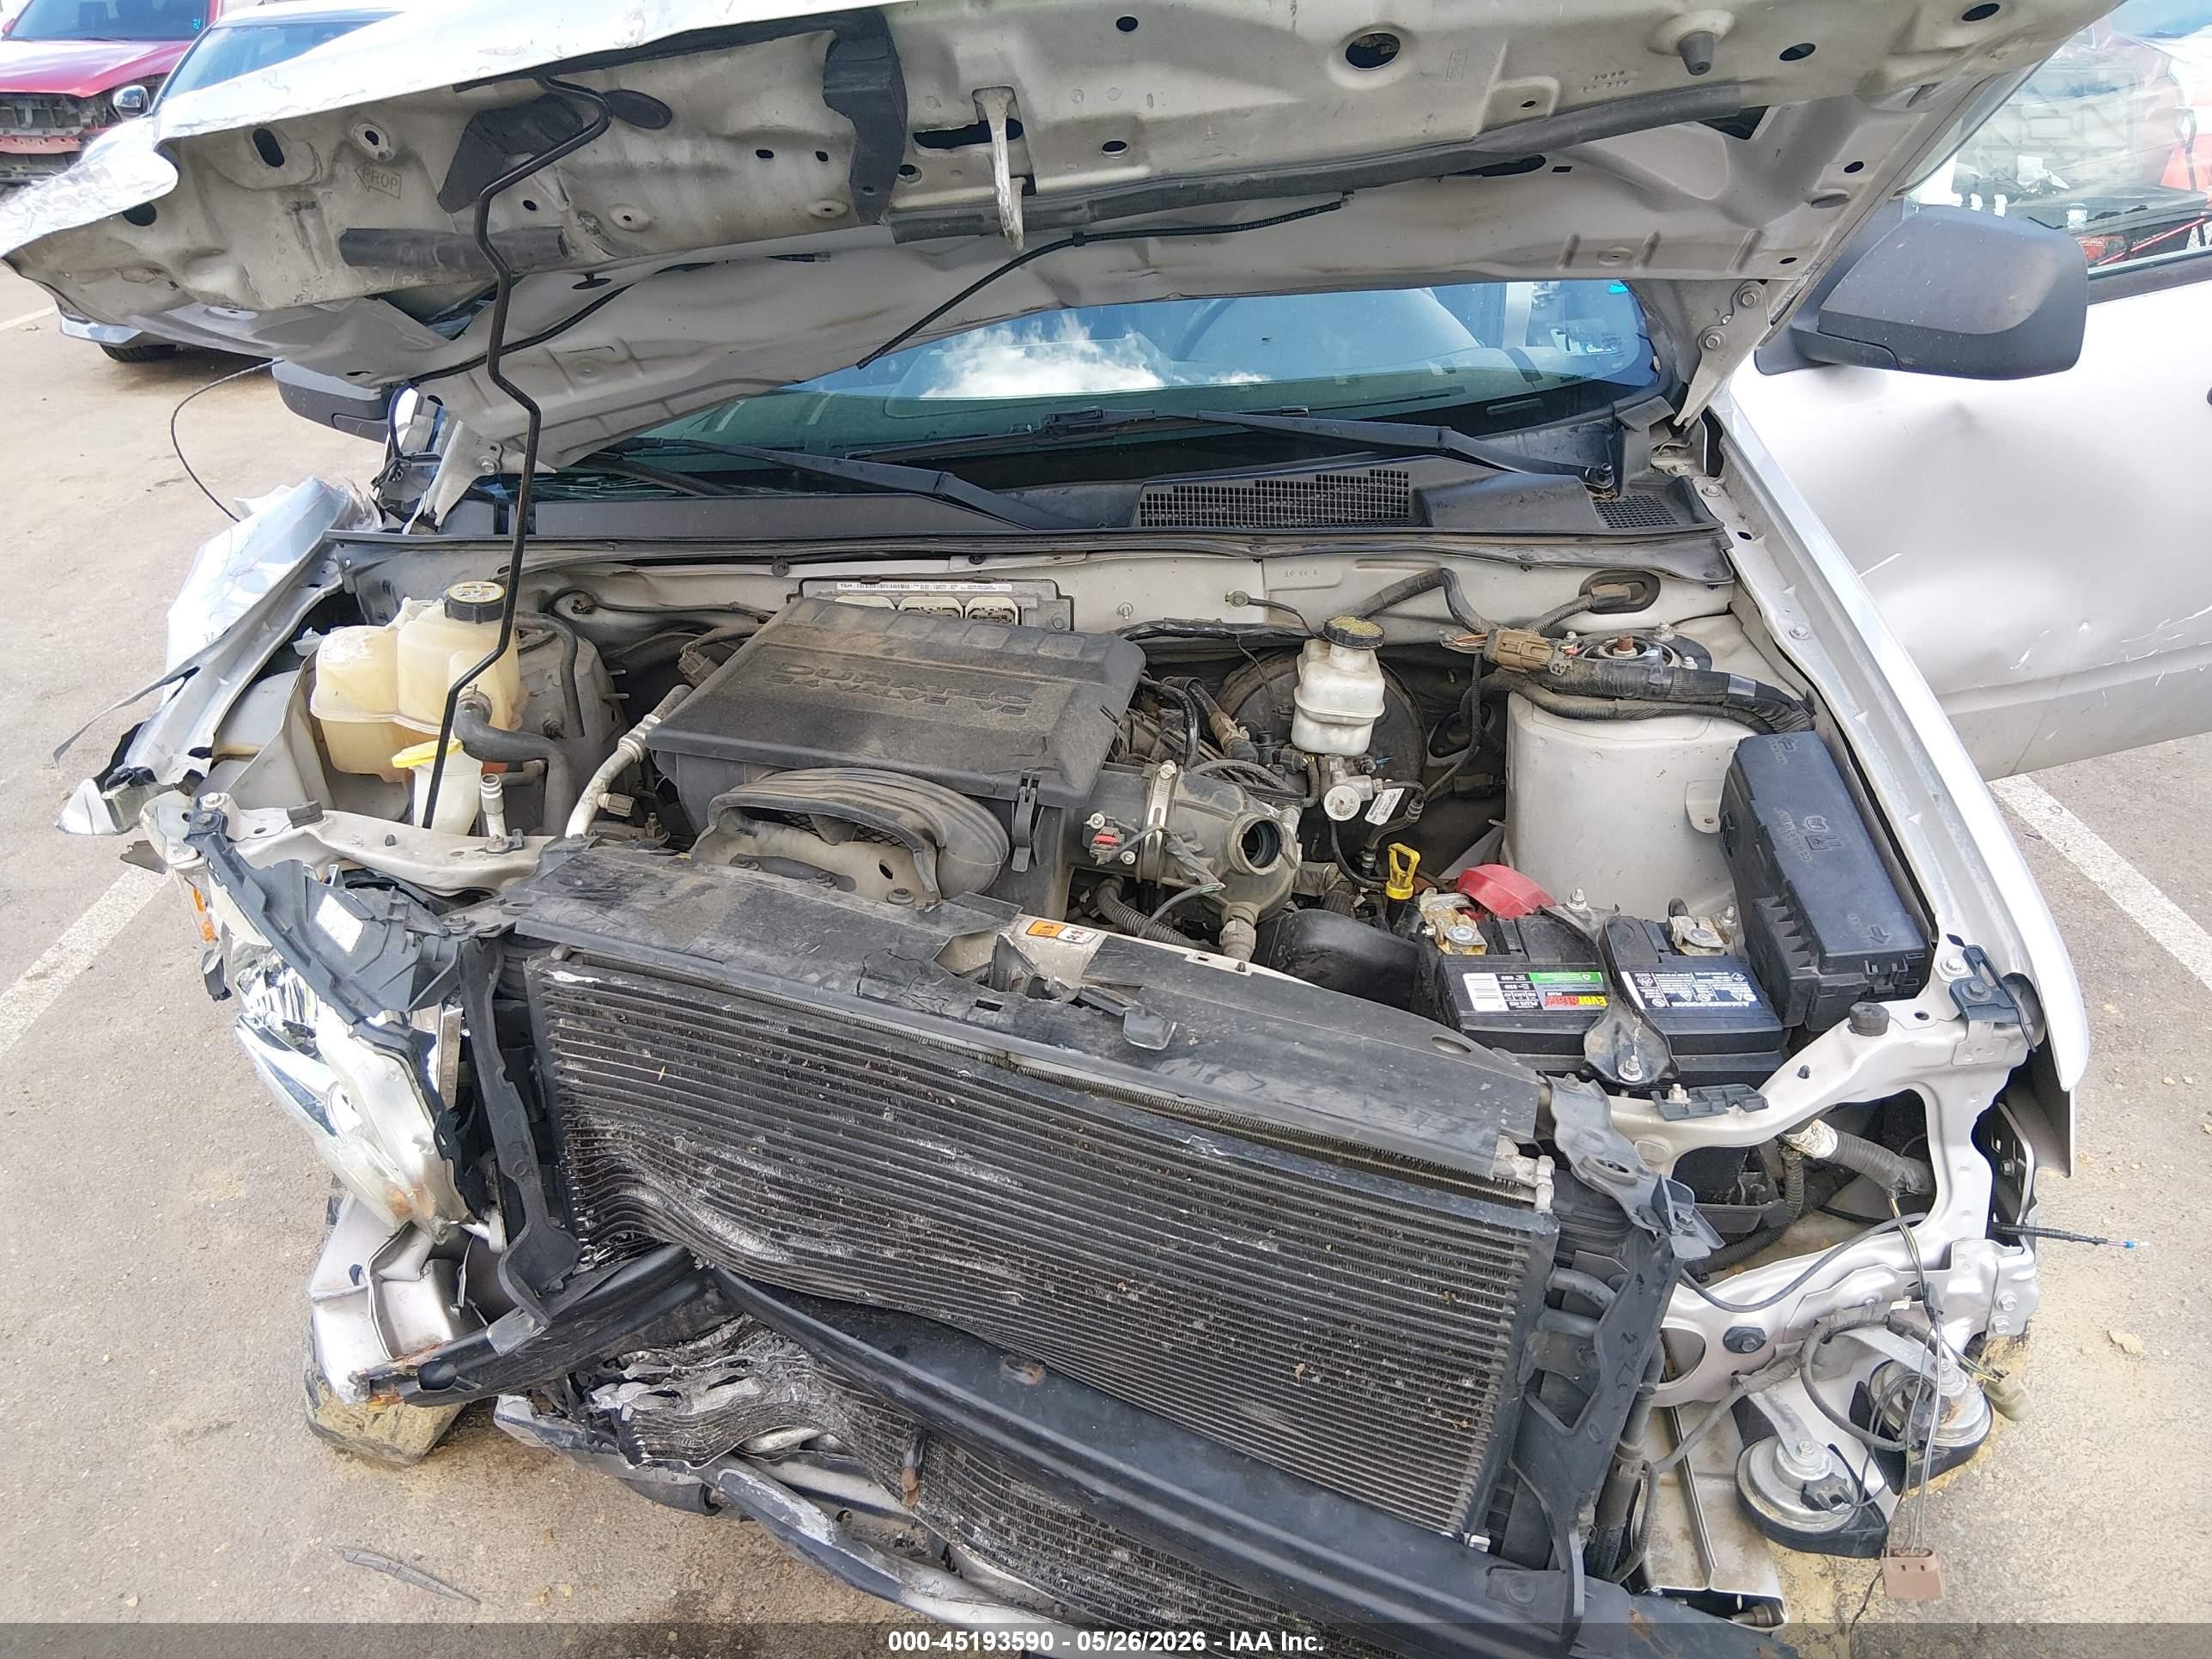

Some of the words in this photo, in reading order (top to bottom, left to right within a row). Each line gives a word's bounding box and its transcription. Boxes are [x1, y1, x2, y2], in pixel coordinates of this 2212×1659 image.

[362, 168, 398, 191] PROP
[763, 673, 820, 689] 24
[834, 681, 951, 707] VALVE
[975, 699, 1028, 716] V6
[776, 661, 1034, 705] DURATEC
